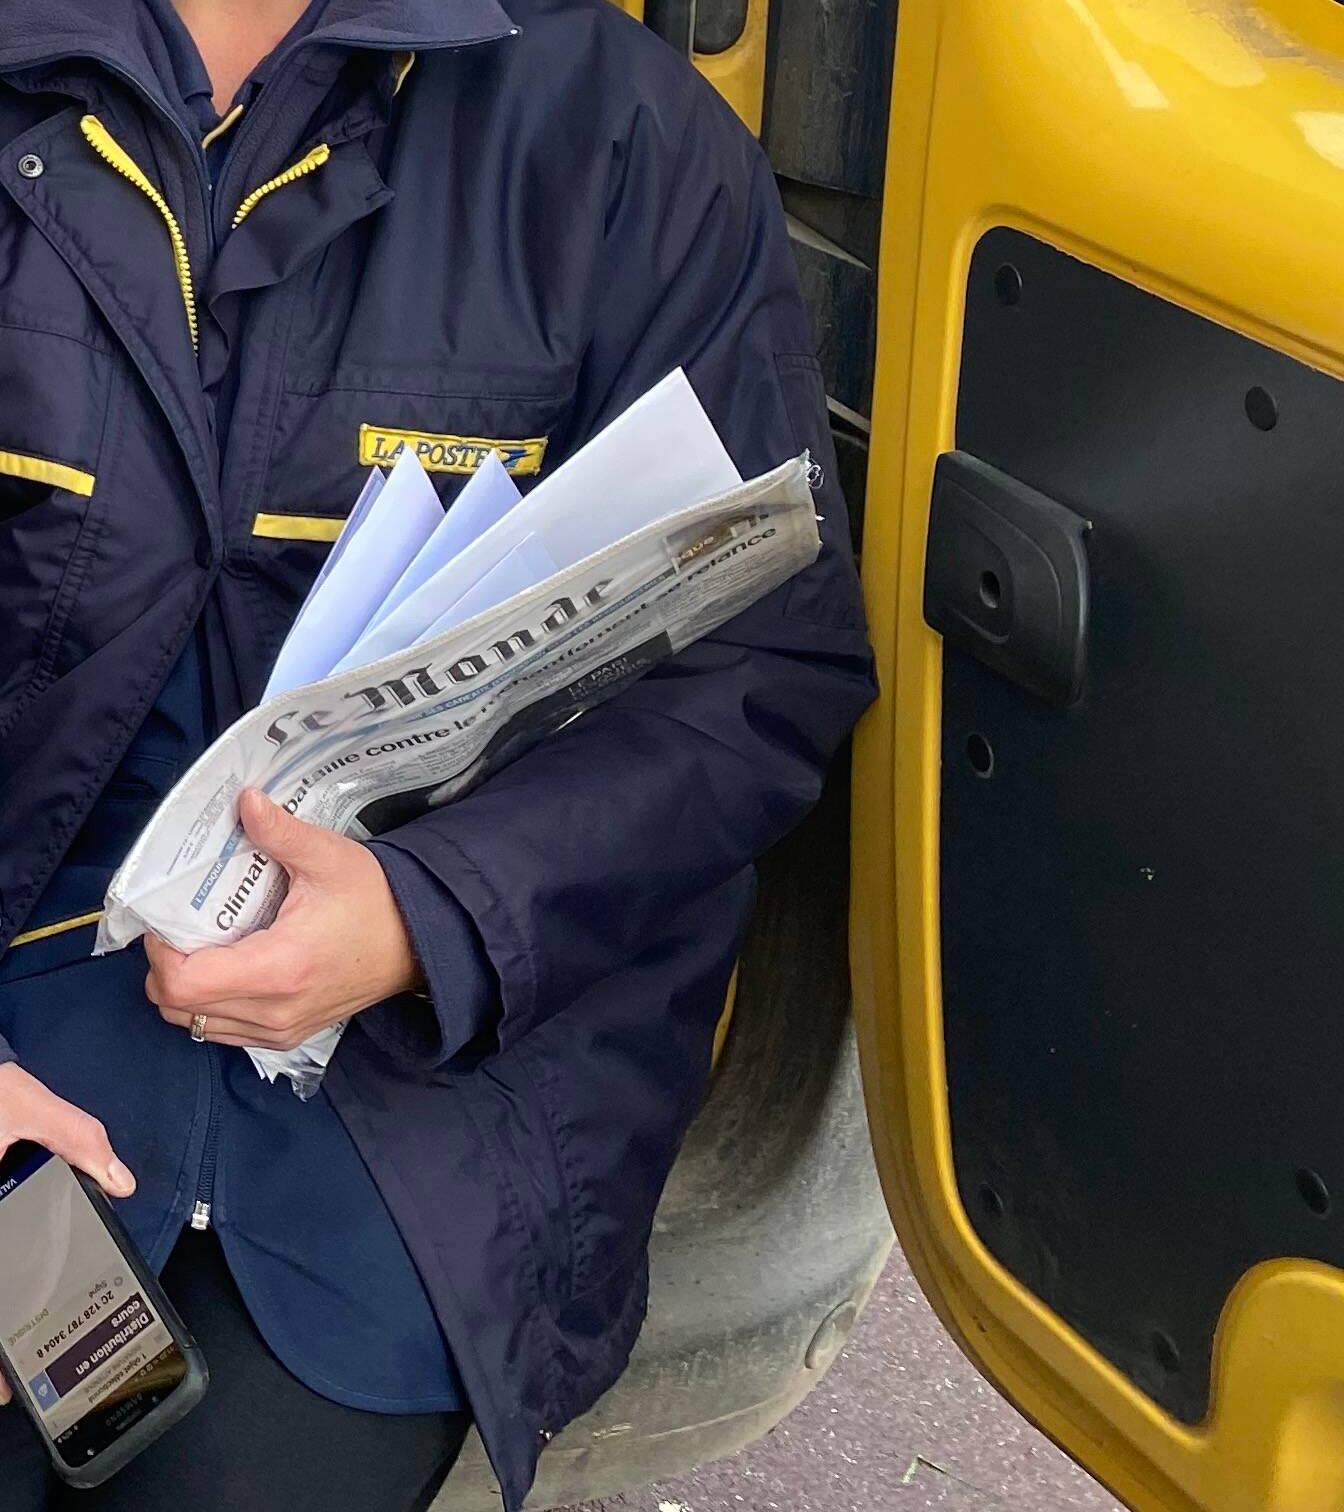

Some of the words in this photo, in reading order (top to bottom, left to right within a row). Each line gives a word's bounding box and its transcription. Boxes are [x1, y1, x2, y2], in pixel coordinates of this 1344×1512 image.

[372, 437, 407, 460] LA
[416, 440, 493, 467] POSTE
[365, 726, 450, 759] contre
[111, 1300, 141, 1328] cours
[90, 1312, 150, 1365] Distribution
[75, 1360, 91, 1376] en
